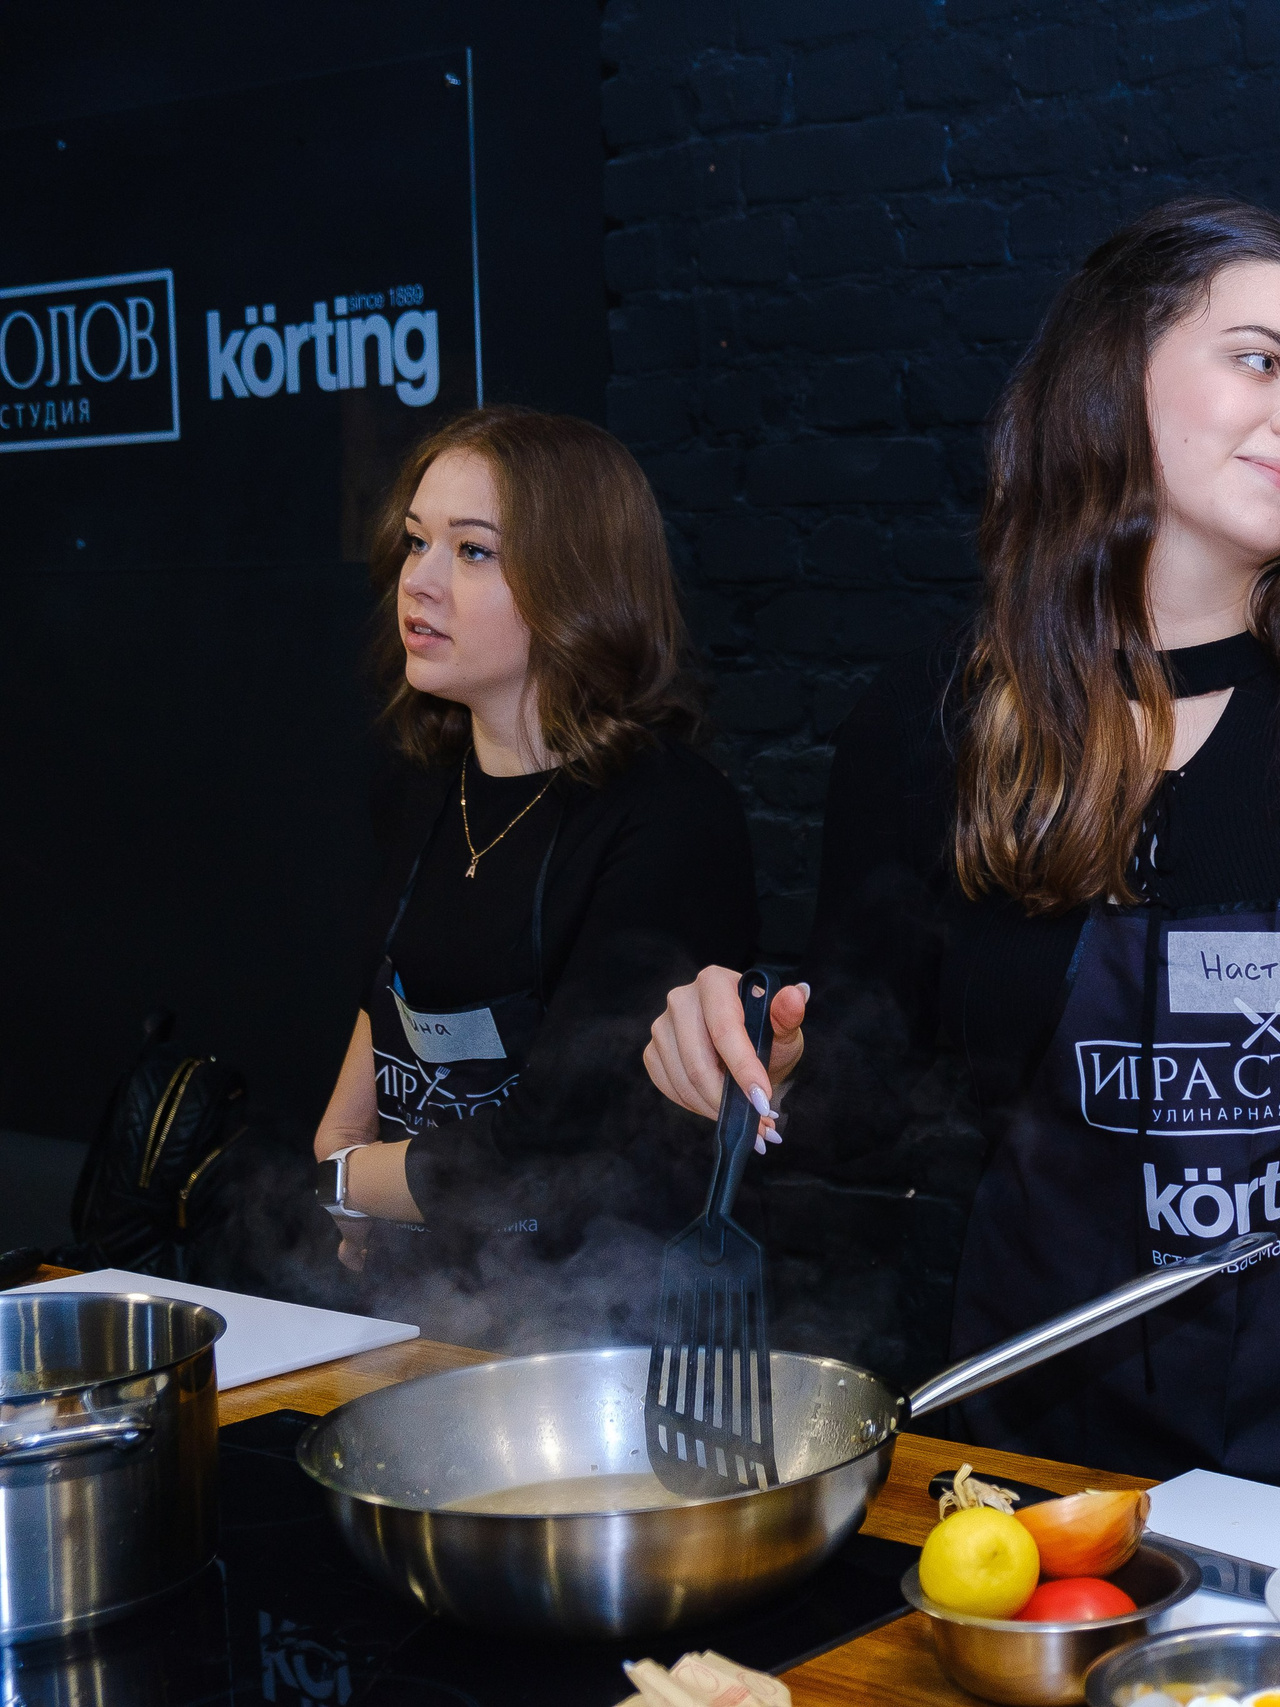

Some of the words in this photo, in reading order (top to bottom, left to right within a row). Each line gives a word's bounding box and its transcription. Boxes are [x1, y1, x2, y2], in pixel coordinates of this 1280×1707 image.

[350, 290, 385, 312] since
[389, 283, 424, 307] 1889
[207, 296, 440, 407] körting
[0, 397, 91, 431] СТУДИЯ
